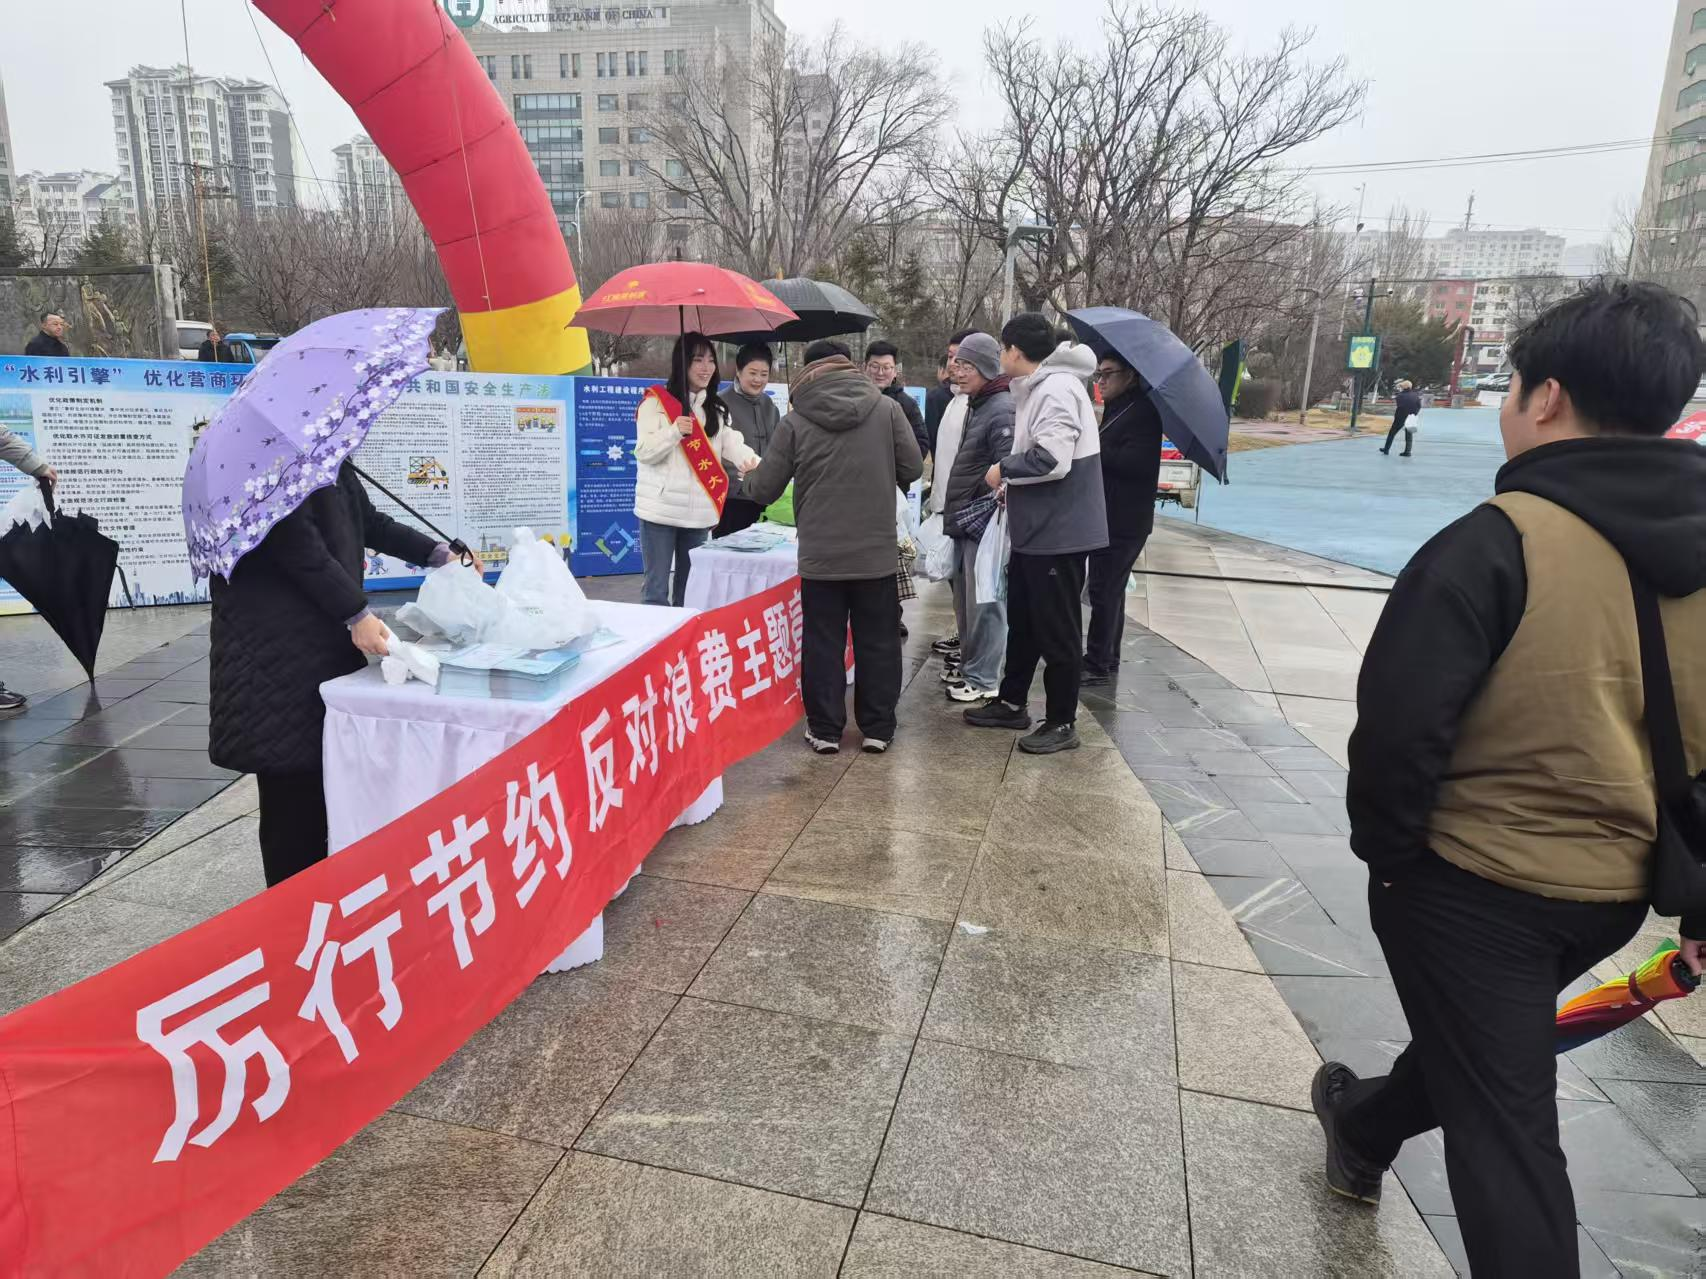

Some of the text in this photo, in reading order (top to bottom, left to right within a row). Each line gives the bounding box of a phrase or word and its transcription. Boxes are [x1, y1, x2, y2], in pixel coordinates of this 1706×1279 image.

[493, 7, 653, 24] AGRICULTURAL BANK OF CHINA
